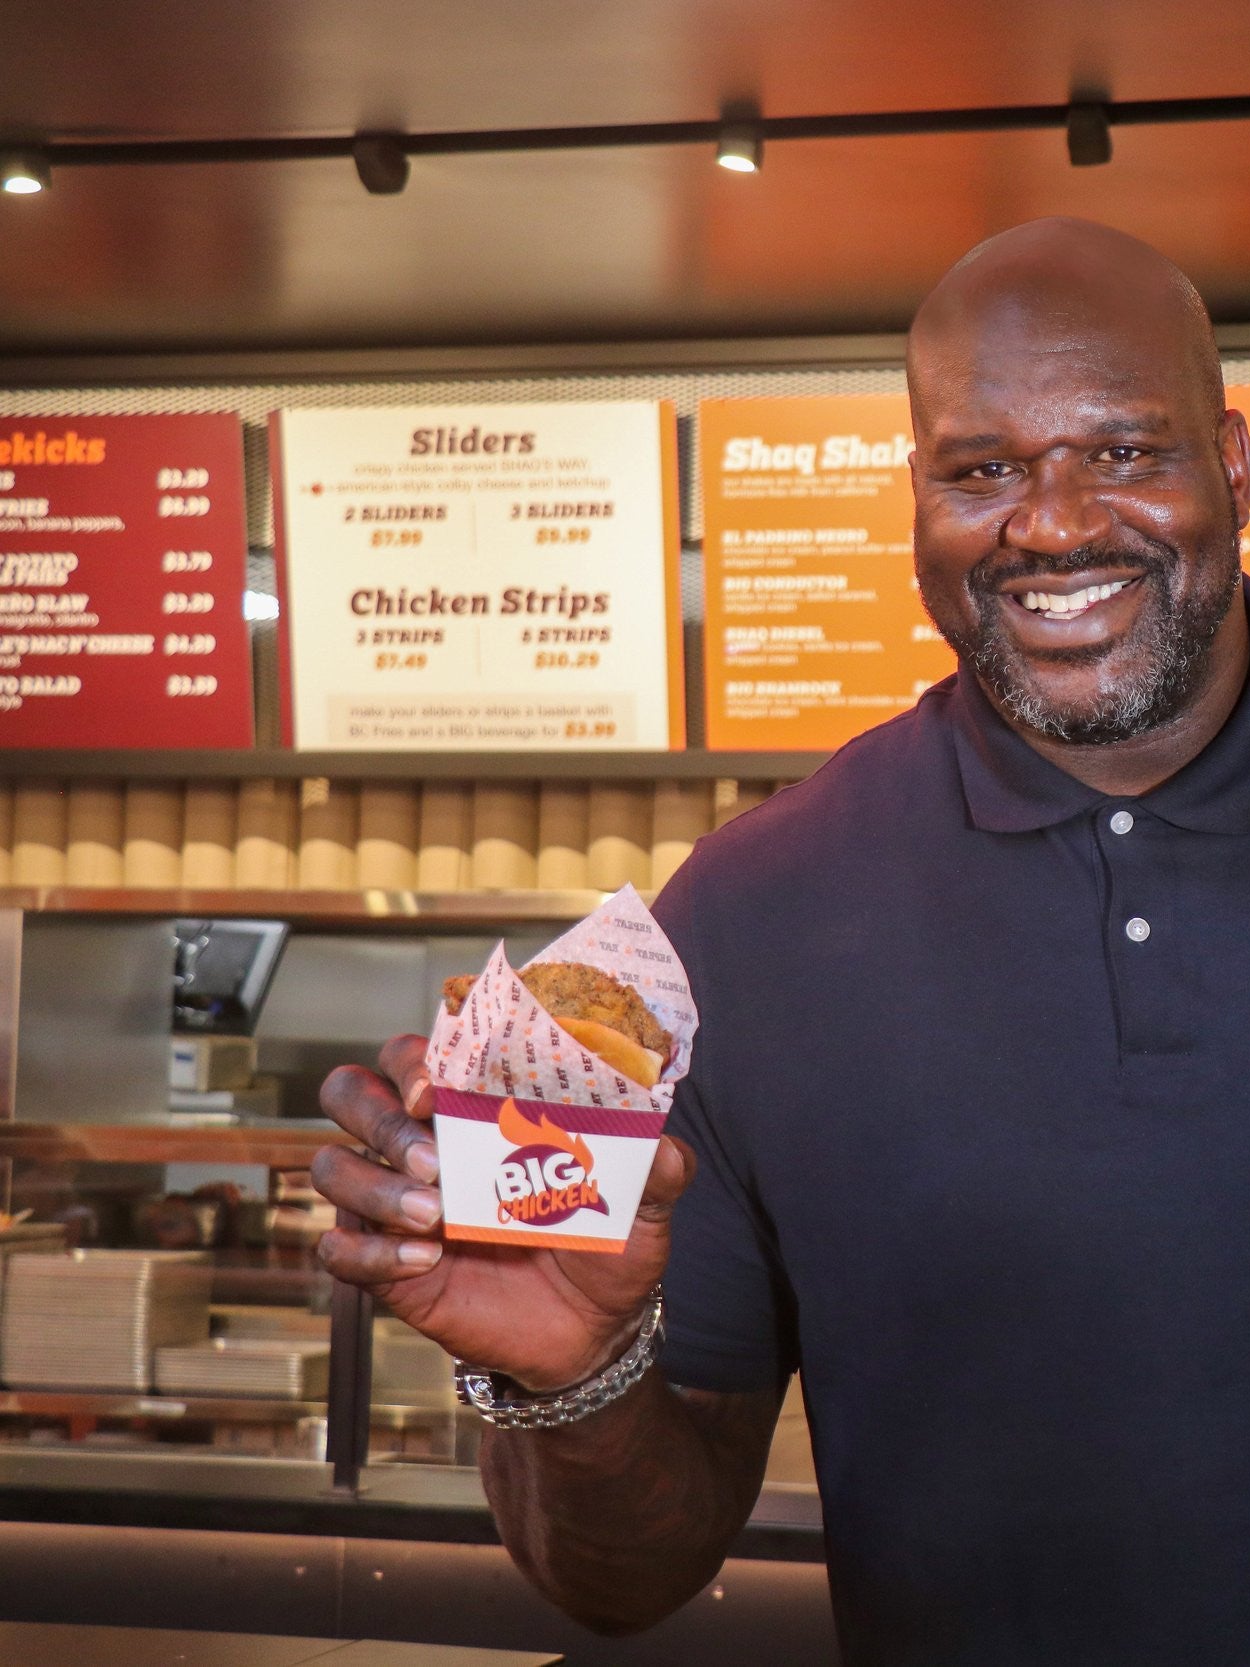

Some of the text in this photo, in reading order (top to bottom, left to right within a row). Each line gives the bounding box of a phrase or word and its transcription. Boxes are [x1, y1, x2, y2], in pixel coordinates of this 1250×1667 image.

[410, 425, 536, 455] Sliders
[722, 432, 913, 475] Shaq Shak
[344, 504, 449, 523] 2 SLIDERS
[527, 501, 615, 519] SLIDERS
[350, 585, 610, 620] Chicken Strips
[372, 627, 445, 645] STRIPS
[537, 627, 611, 644] STRIPS
[448, 1029, 463, 1049] EAT
[502, 1019, 516, 1097] EPEAT EAT
[526, 1040, 537, 1065] EAT
[556, 1066, 570, 1090] EAT
[498, 1152, 587, 1201] BIG
[497, 1177, 600, 1225] CHICKEN
